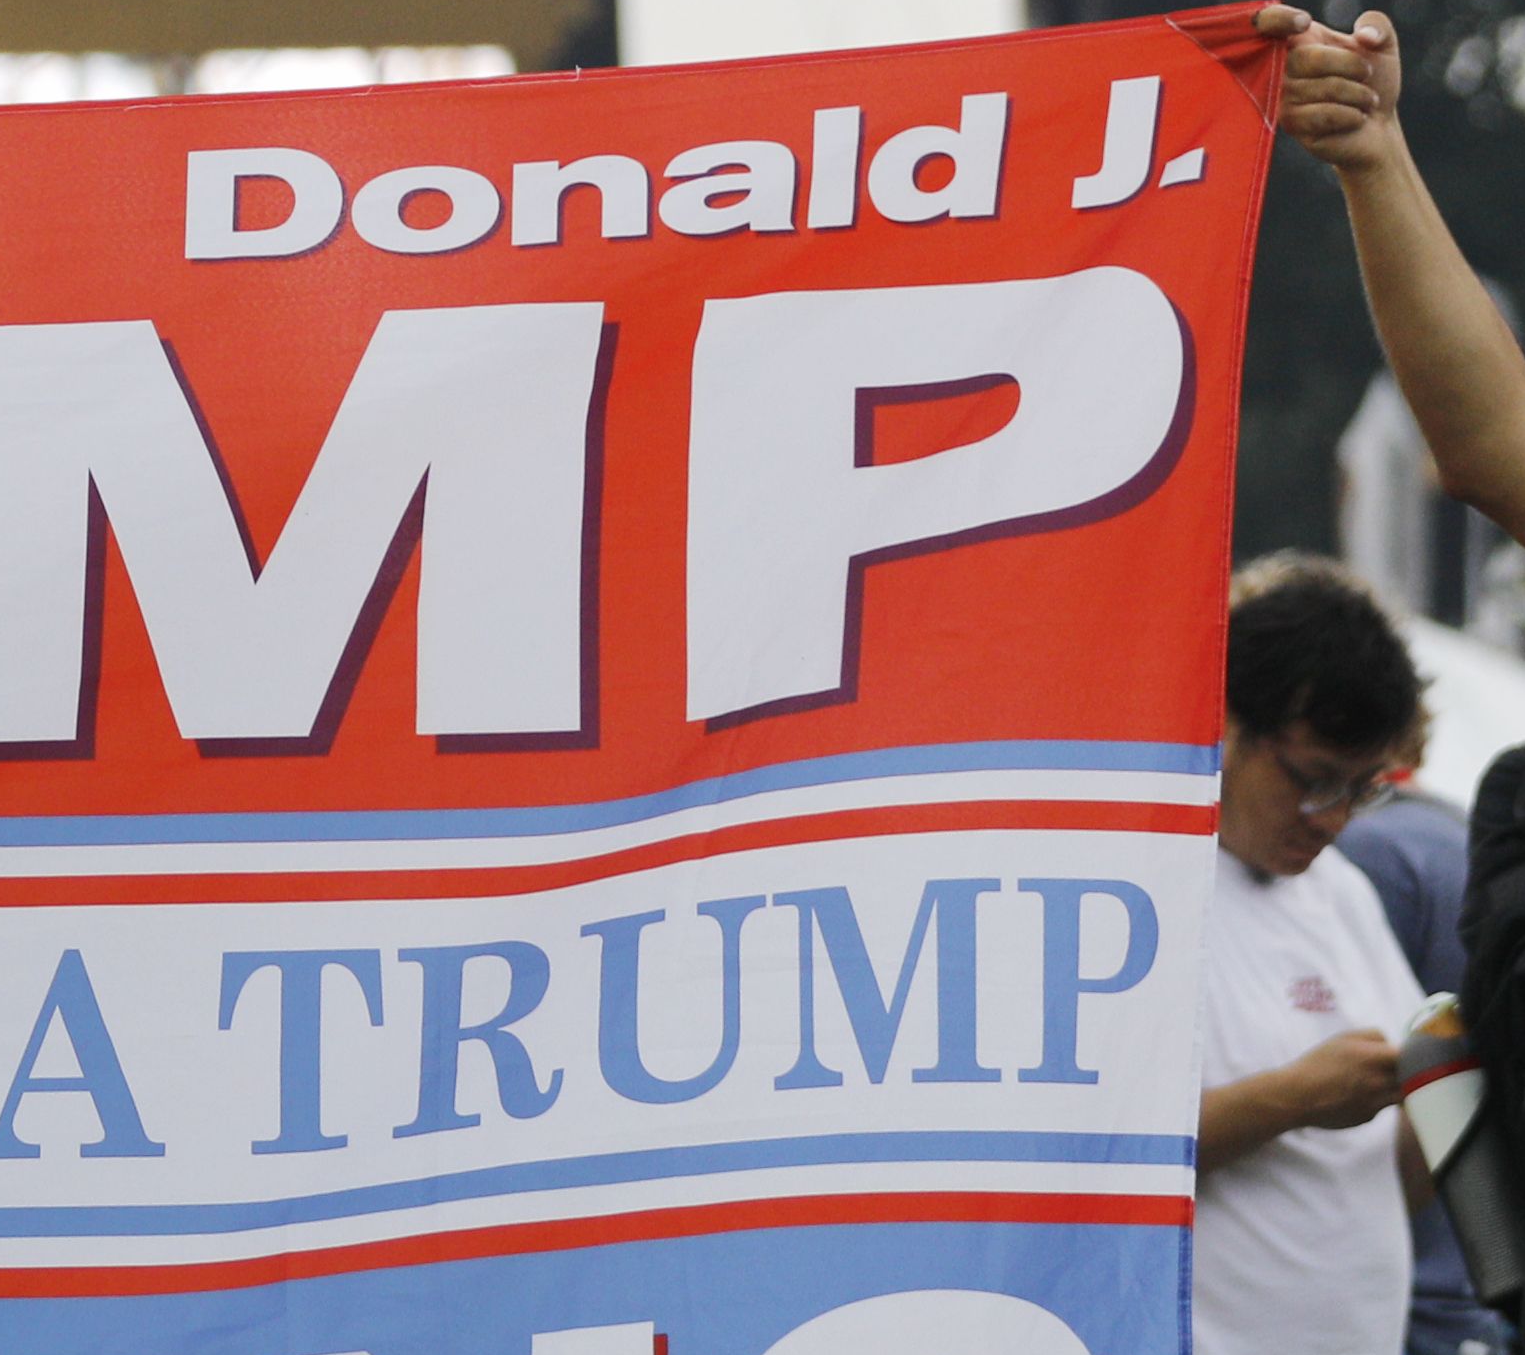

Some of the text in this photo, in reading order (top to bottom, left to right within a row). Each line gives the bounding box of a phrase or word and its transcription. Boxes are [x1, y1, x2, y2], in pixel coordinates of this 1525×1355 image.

[184, 76, 1206, 261] Donald J.
[218, 878, 1159, 1155] TRUMP
